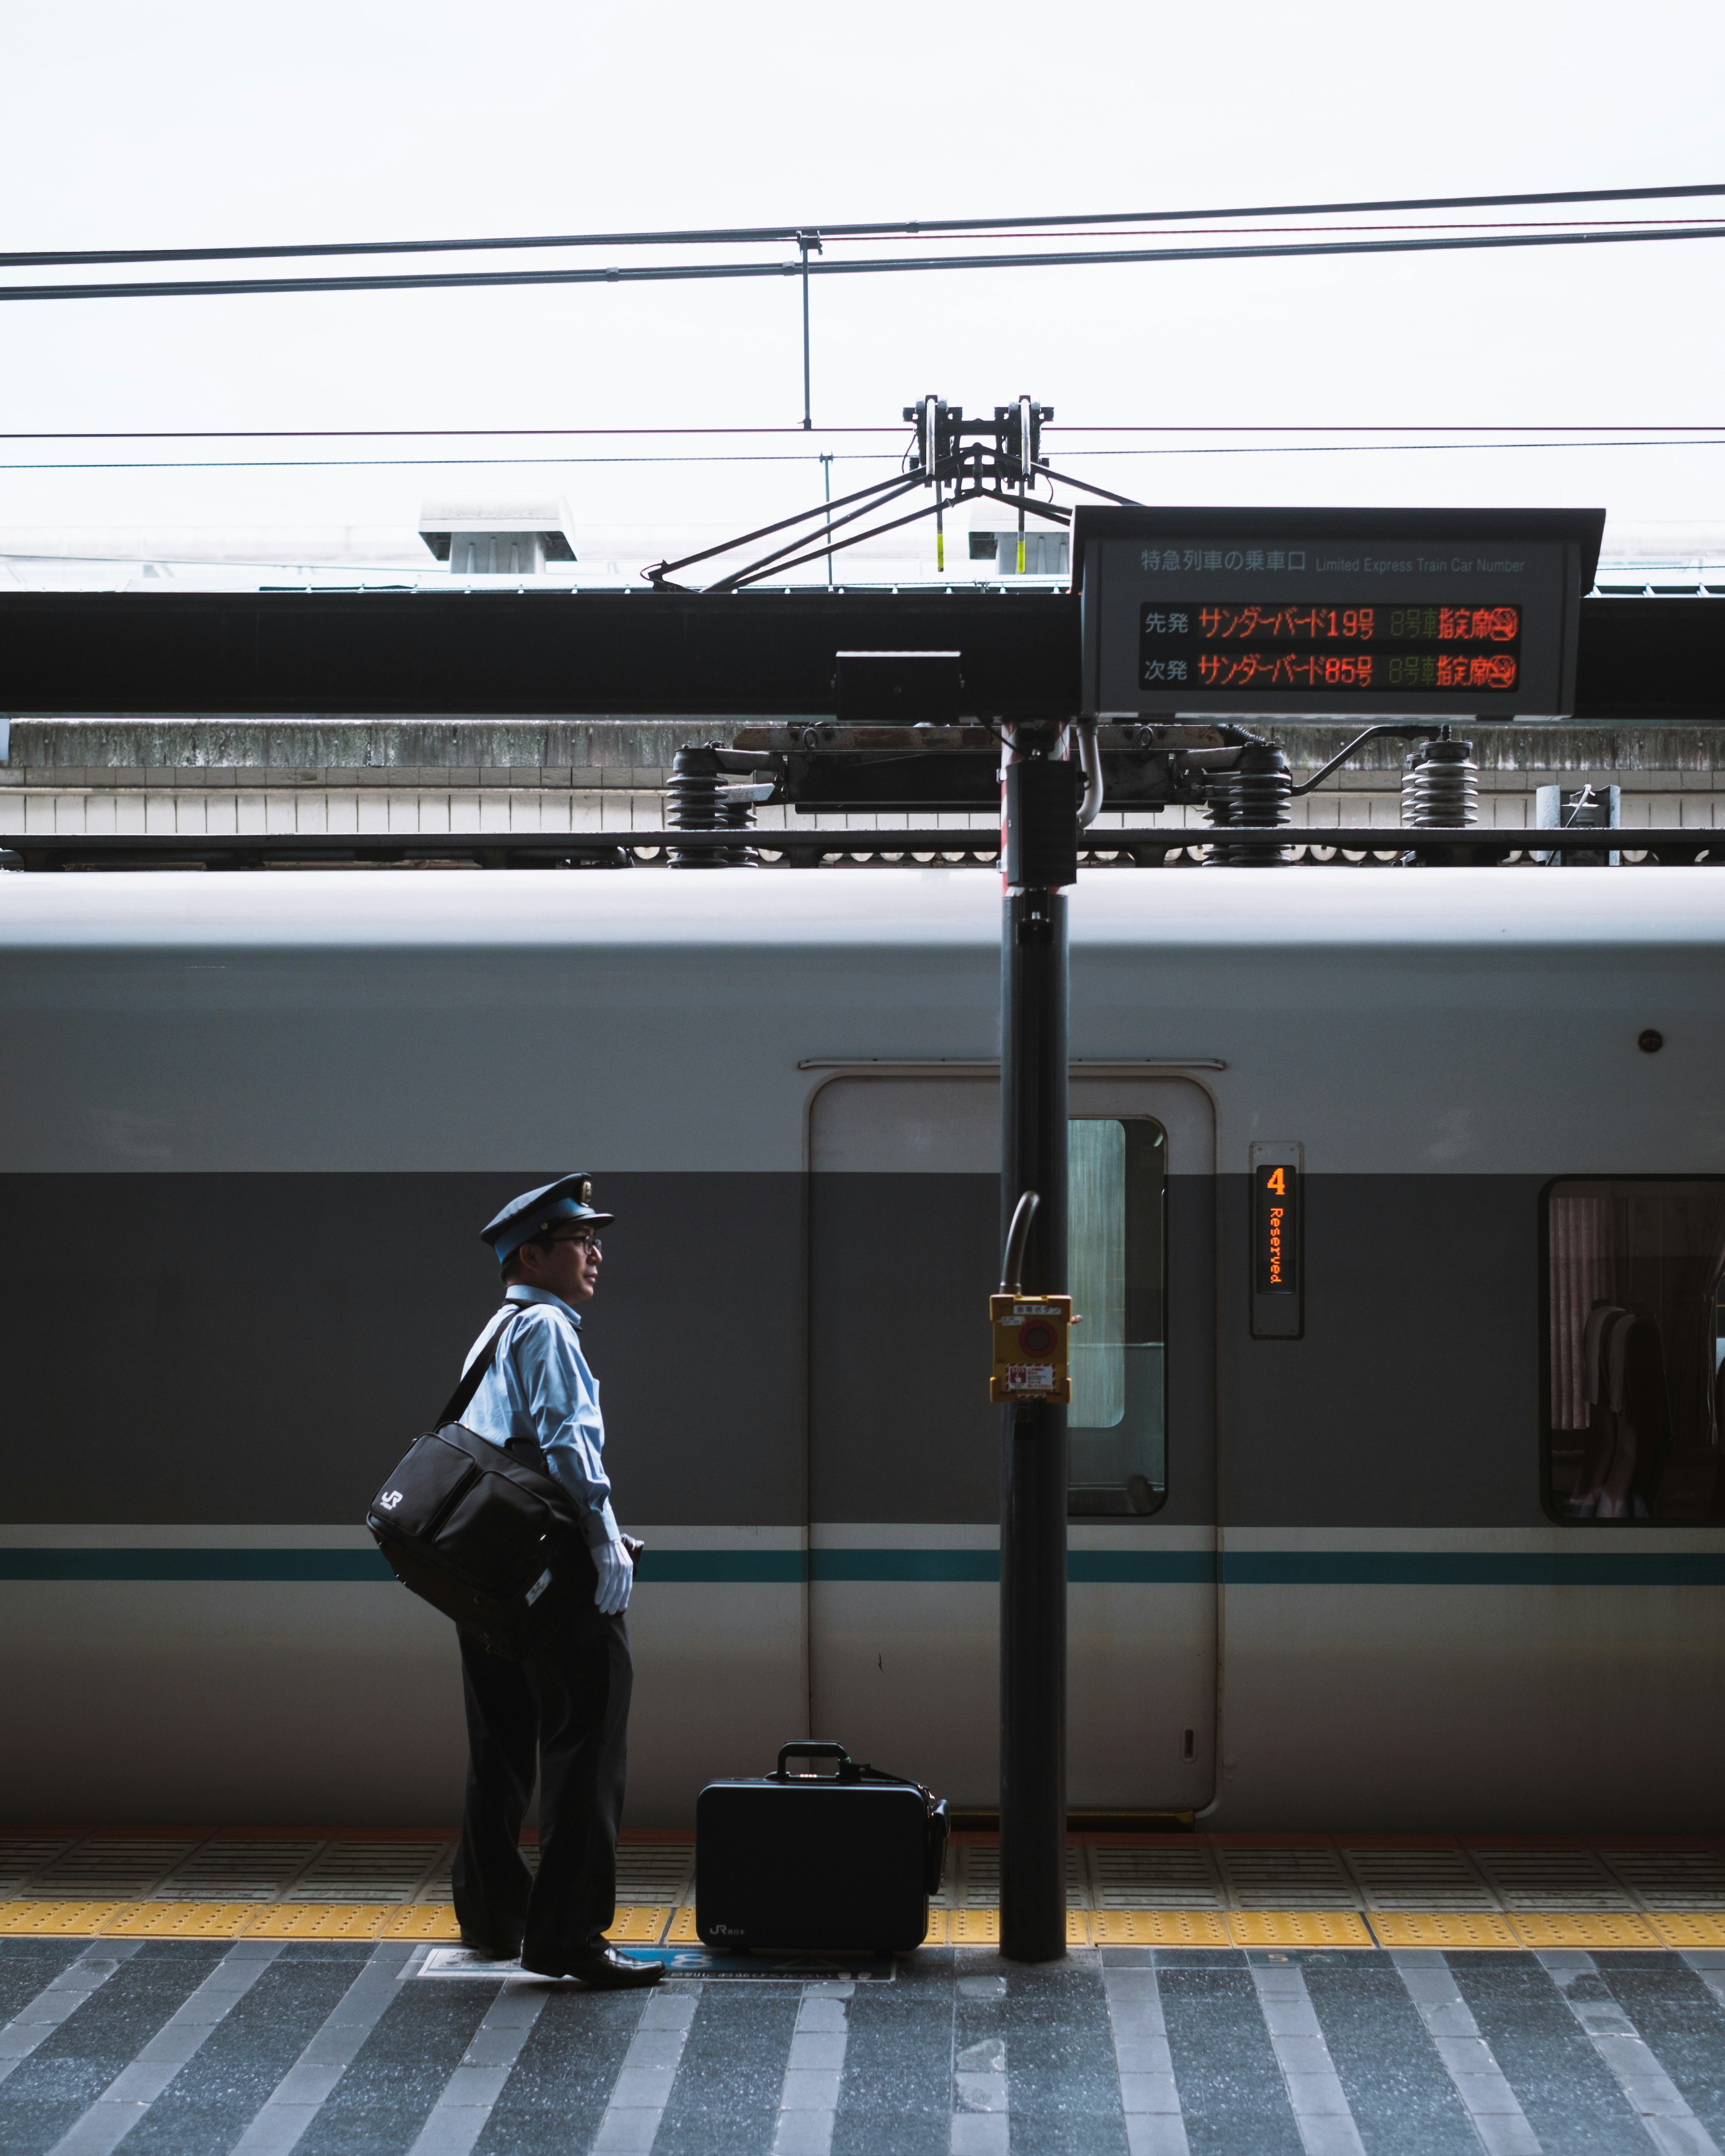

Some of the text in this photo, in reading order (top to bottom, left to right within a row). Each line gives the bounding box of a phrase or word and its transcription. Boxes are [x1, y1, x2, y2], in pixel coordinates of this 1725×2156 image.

[1141, 549, 1525, 575] 特急列車の乗車口 Limited Express Train Car Number
[1145, 612, 1189, 634] 先発
[1199, 606, 1375, 640] サンダーバード19号
[1144, 660, 1188, 681] 次発
[1198, 653, 1373, 687] サンダーバード85号
[1267, 1168, 1285, 1195] 4
[1270, 1208, 1284, 1284] Reserved
[381, 1490, 403, 1507] JR
[710, 1925, 726, 1934] JR
[671, 1954, 713, 1968] 8
